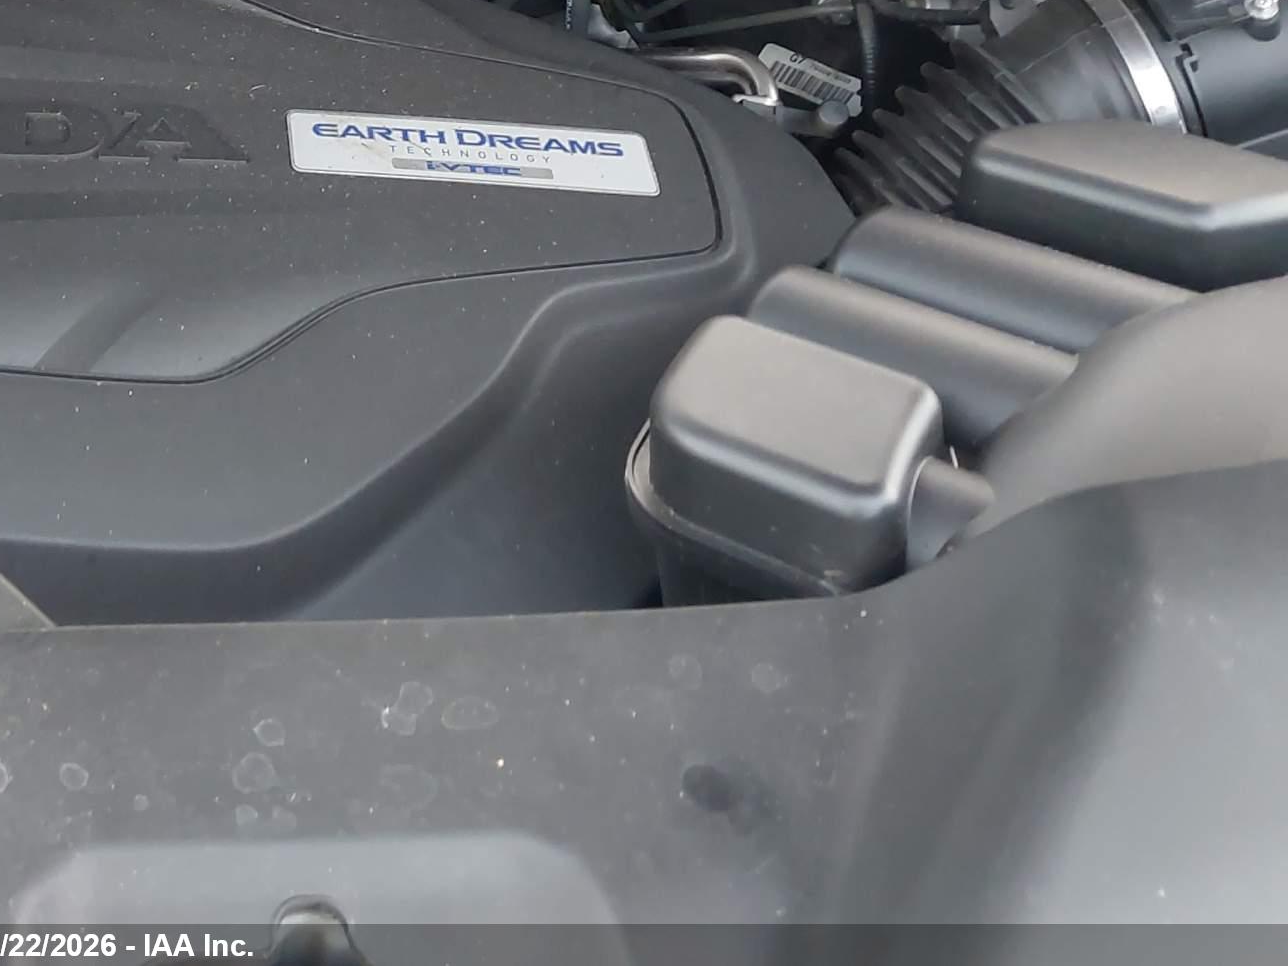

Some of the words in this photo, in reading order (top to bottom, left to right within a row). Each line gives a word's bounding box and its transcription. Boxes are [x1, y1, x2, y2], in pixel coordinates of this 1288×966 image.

[312, 122, 447, 145] EARTH
[455, 128, 625, 157] DREAMS
[390, 145, 552, 163] TECHNOLOGY
